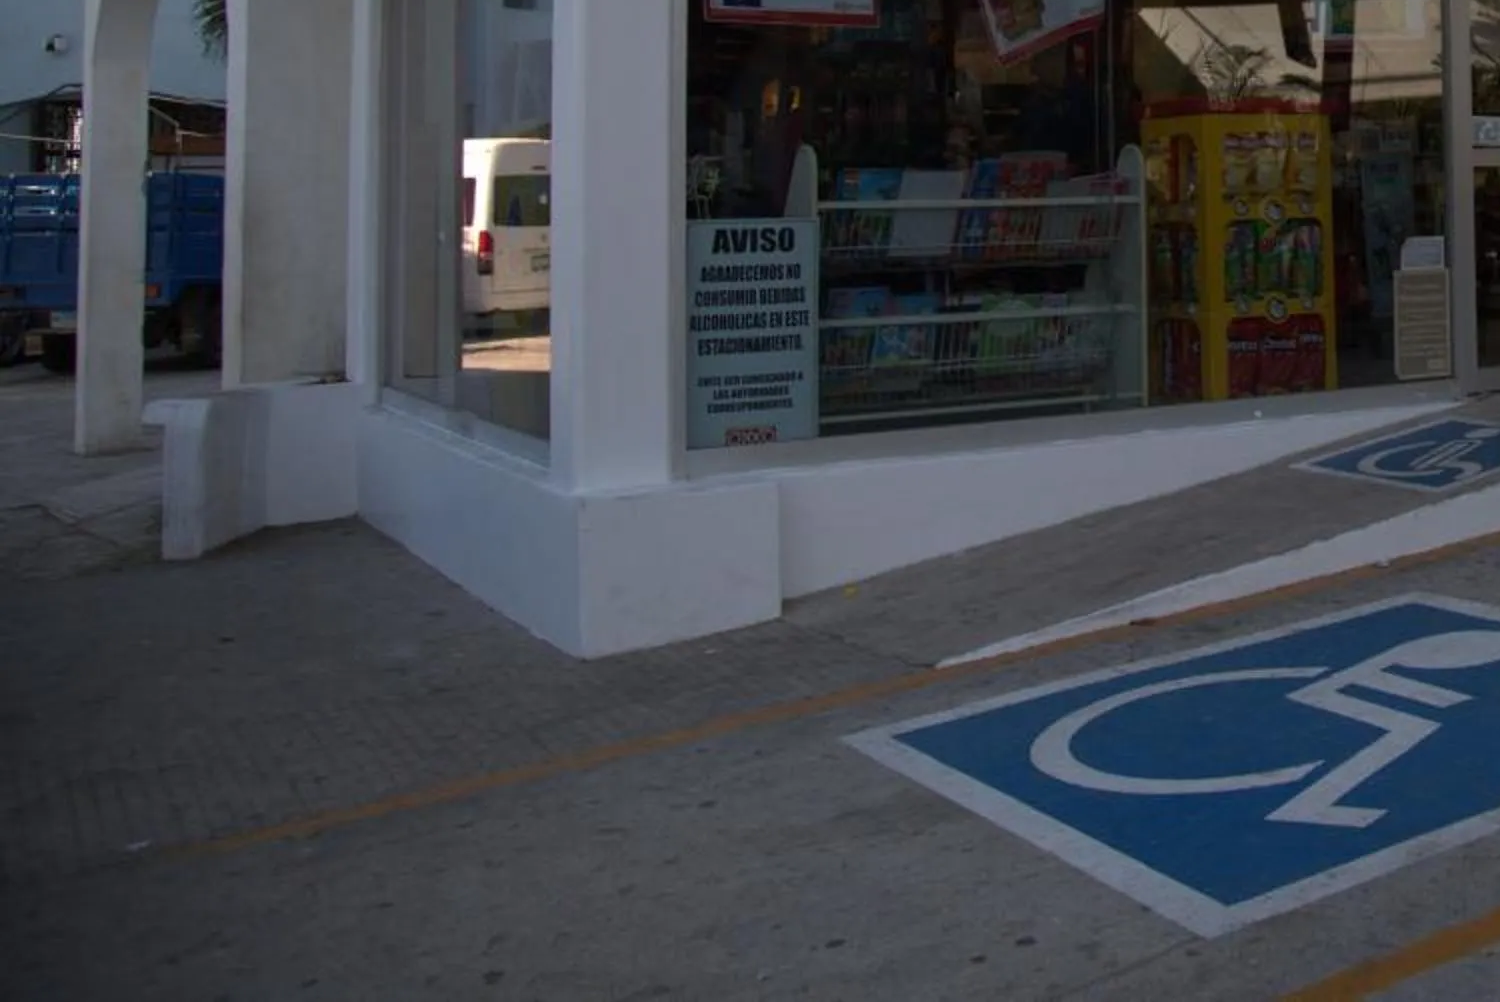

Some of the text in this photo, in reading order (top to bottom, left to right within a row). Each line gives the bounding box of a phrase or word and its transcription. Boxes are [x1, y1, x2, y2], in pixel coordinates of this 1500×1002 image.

[712, 227, 795, 254] AVISO
[701, 263, 801, 282] AGRADECEMOS NO
[695, 289, 757, 307] CONSUMIR
[690, 310, 809, 331] ALCOHOLICAS EN ESTE
